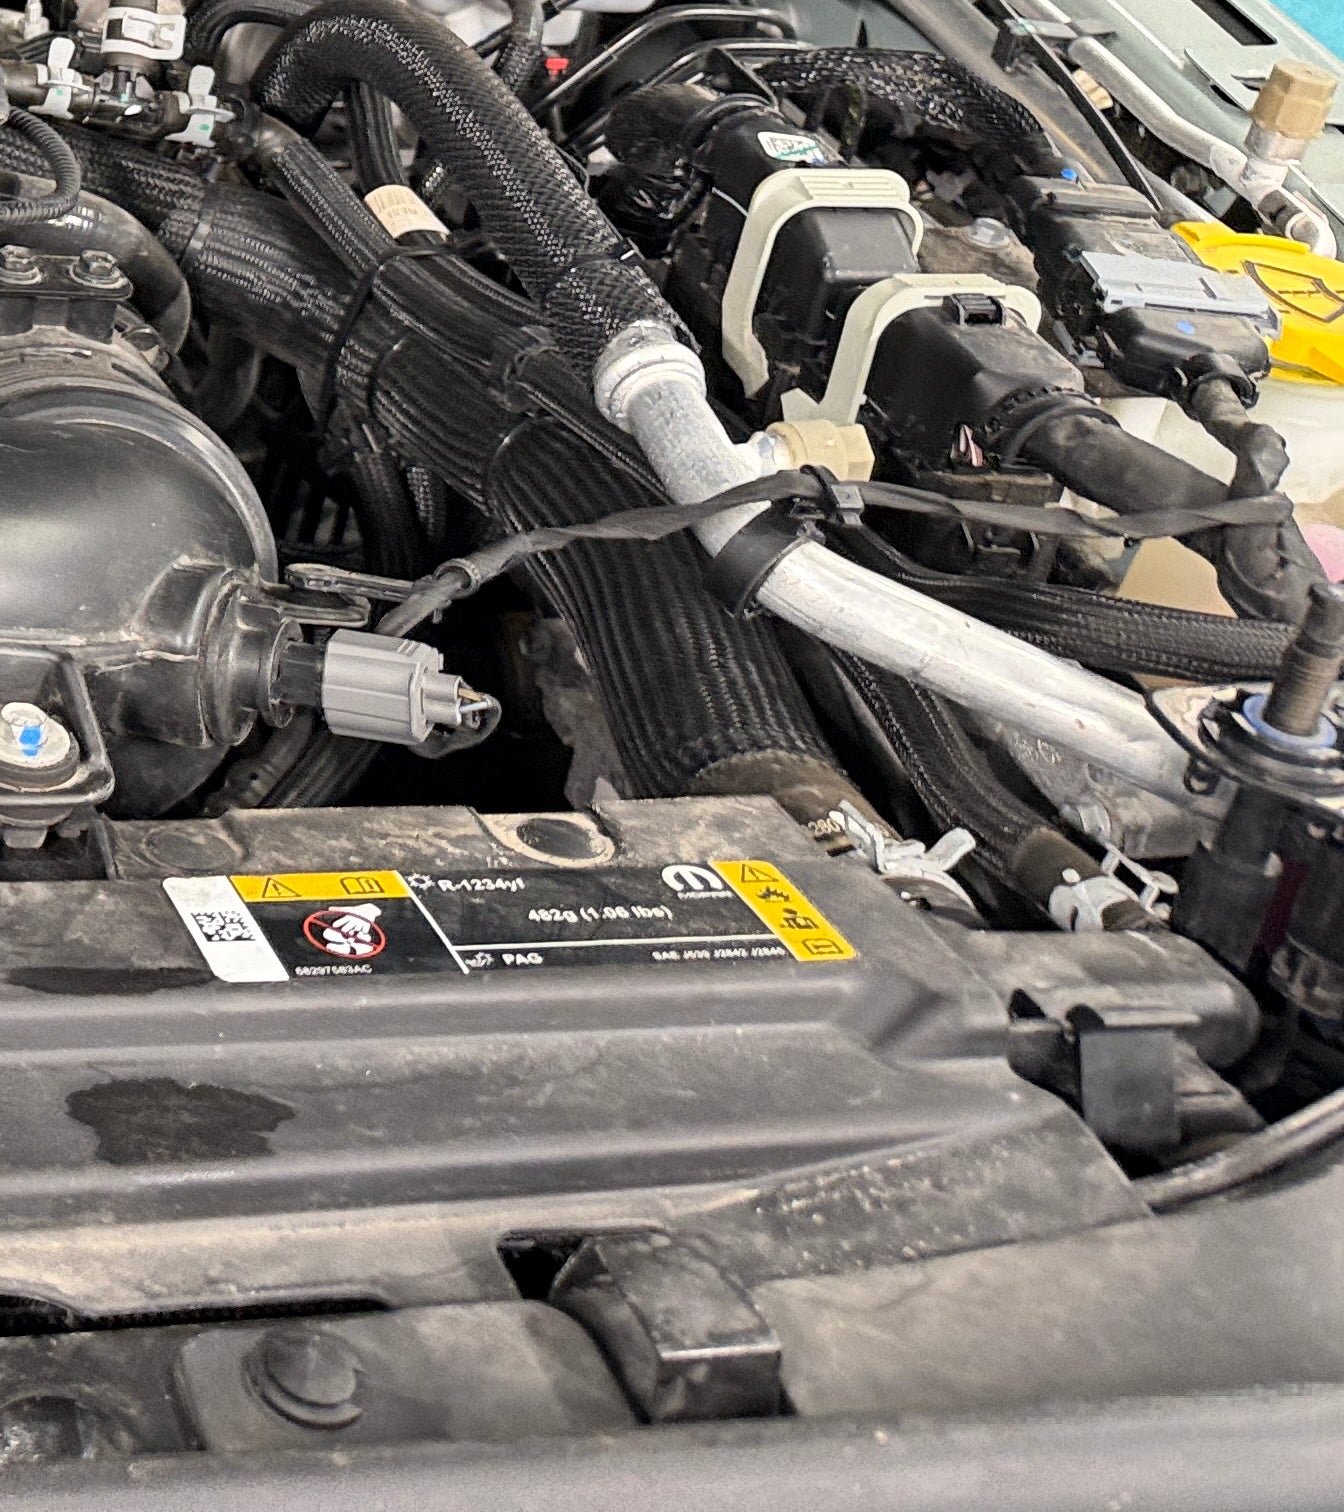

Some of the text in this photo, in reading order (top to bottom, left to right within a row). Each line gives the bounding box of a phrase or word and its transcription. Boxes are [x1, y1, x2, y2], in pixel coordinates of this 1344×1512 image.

[528, 908, 579, 923] 482g
[631, 905, 673, 920] lbs)
[501, 952, 544, 966] PAG
